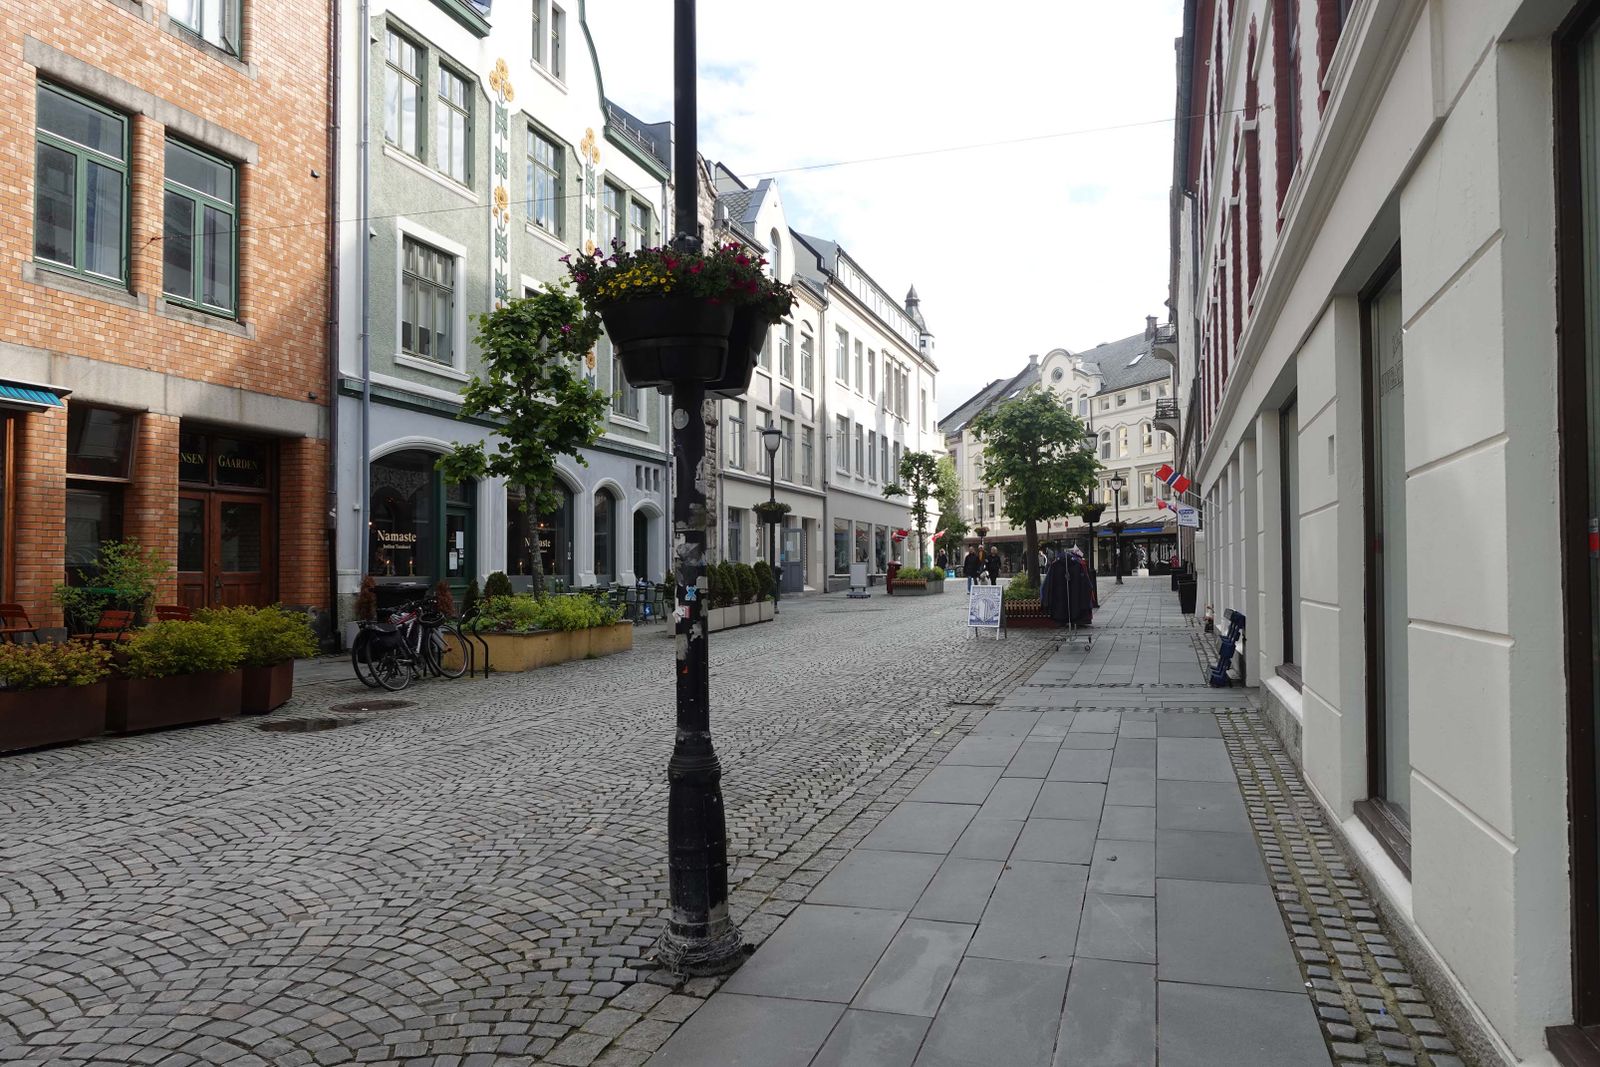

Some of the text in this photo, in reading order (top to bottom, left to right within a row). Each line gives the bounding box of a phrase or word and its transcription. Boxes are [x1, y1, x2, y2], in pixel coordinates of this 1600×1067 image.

[181, 452, 204, 464] NSEN
[377, 529, 417, 542] Namaste
[524, 536, 551, 548] Naste
